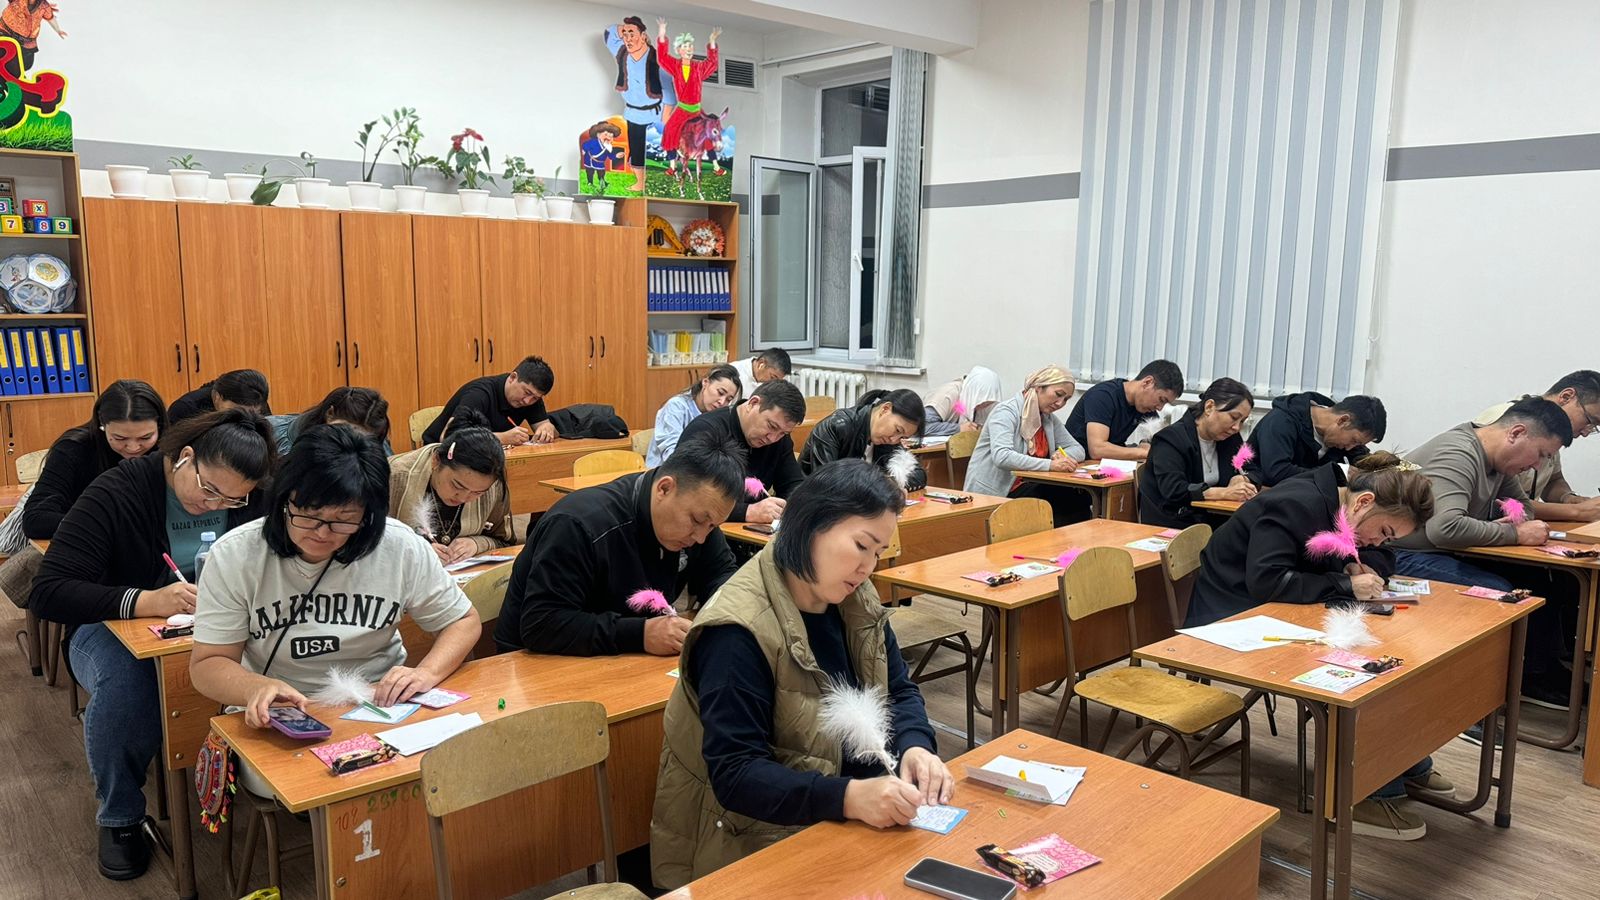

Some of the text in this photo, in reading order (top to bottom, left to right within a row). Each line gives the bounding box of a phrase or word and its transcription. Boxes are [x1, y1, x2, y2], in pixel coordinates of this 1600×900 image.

[7, 220, 15, 228] 7
[41, 222, 48, 230] 8
[193, 517, 221, 528] REPUBLIC
[249, 592, 401, 640] CALIFORNIA
[295, 639, 335, 656] USA
[353, 818, 381, 862] 1
